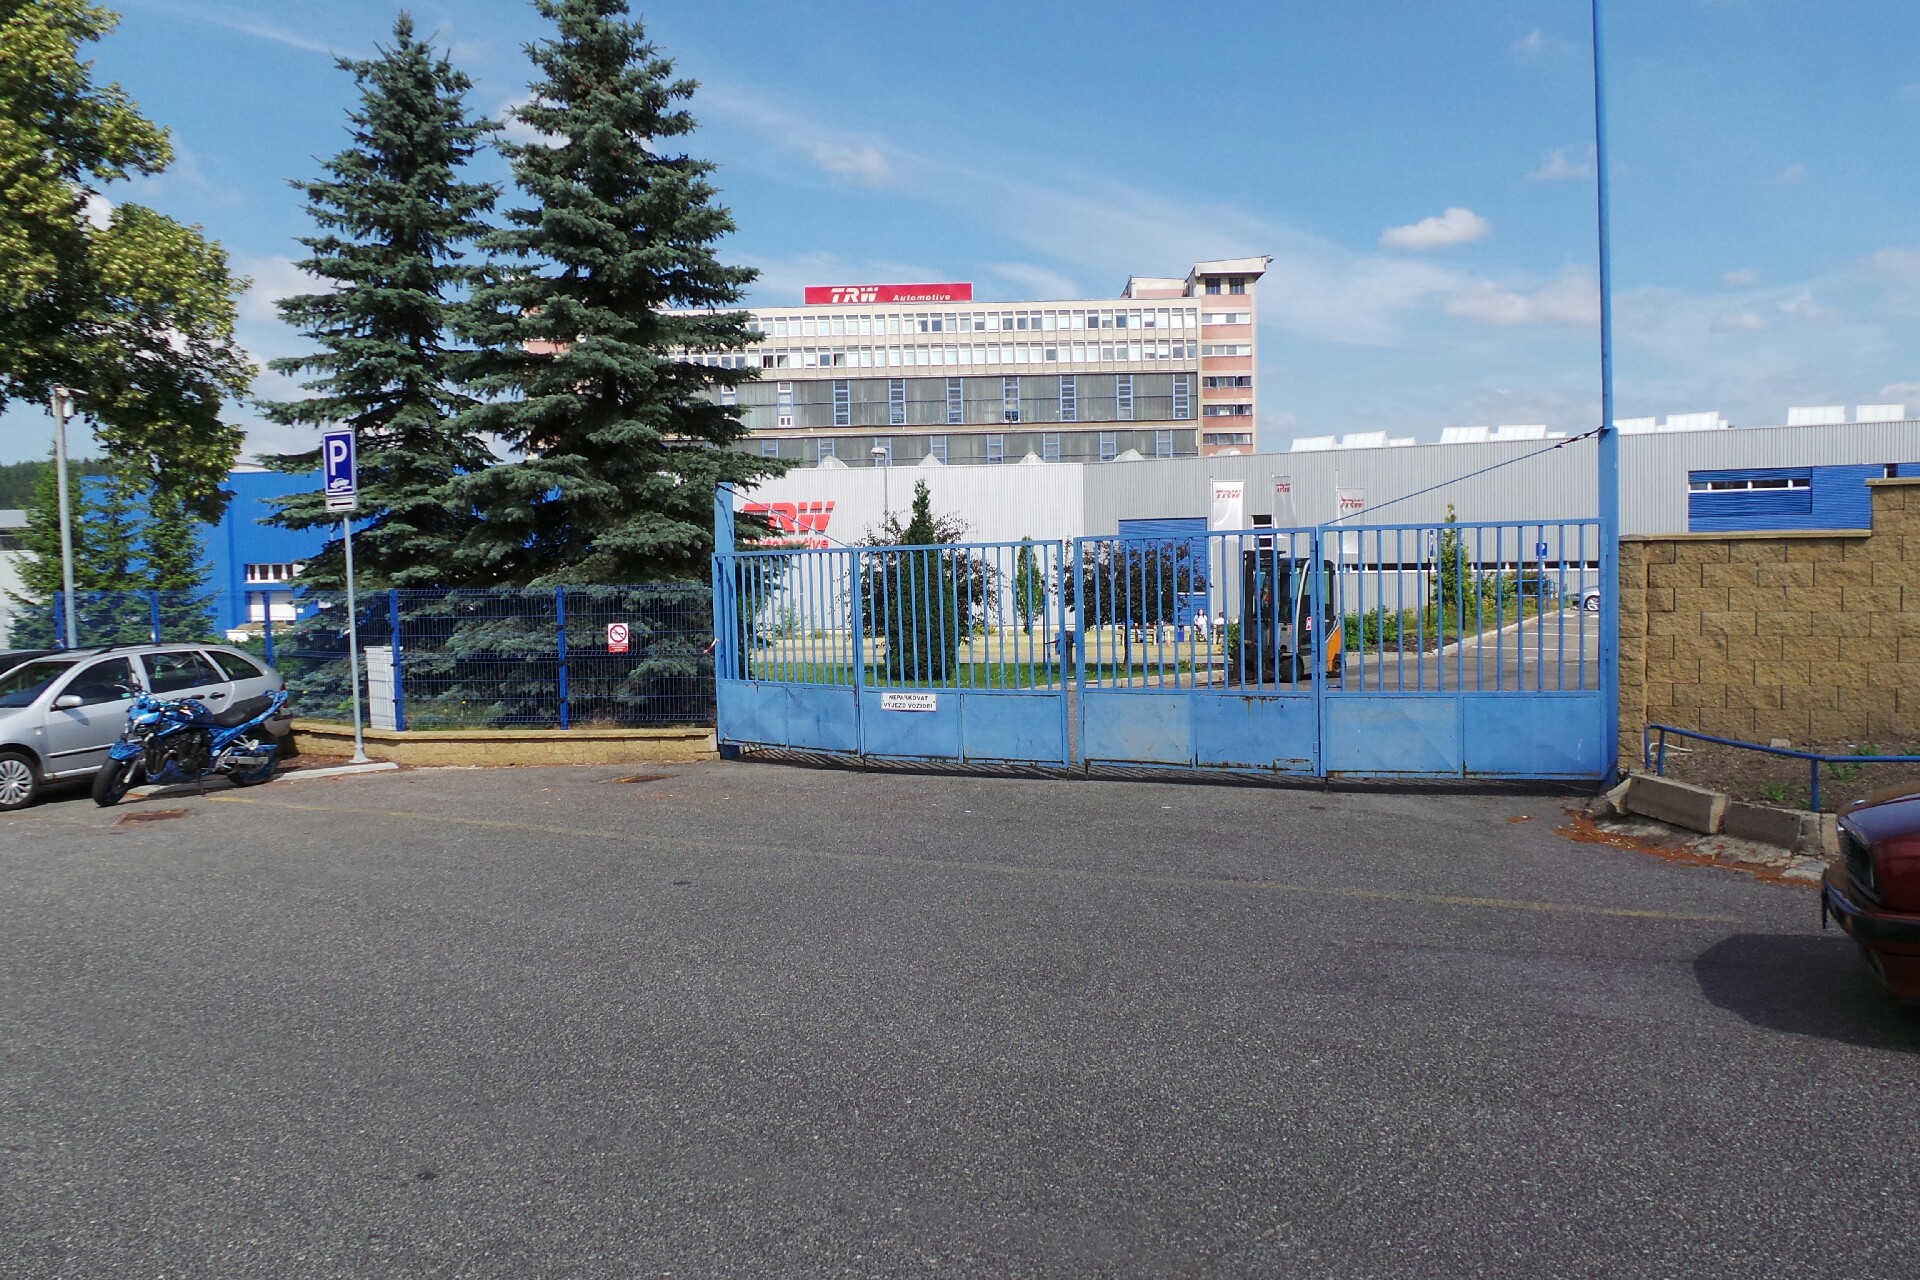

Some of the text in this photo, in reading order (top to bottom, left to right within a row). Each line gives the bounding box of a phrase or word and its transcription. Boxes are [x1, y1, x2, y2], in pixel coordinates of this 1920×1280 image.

[832, 287, 951, 302] TRW Automotive
[329, 440, 348, 476] P
[1216, 490, 1241, 499] TRW
[1340, 499, 1364, 508] TRW
